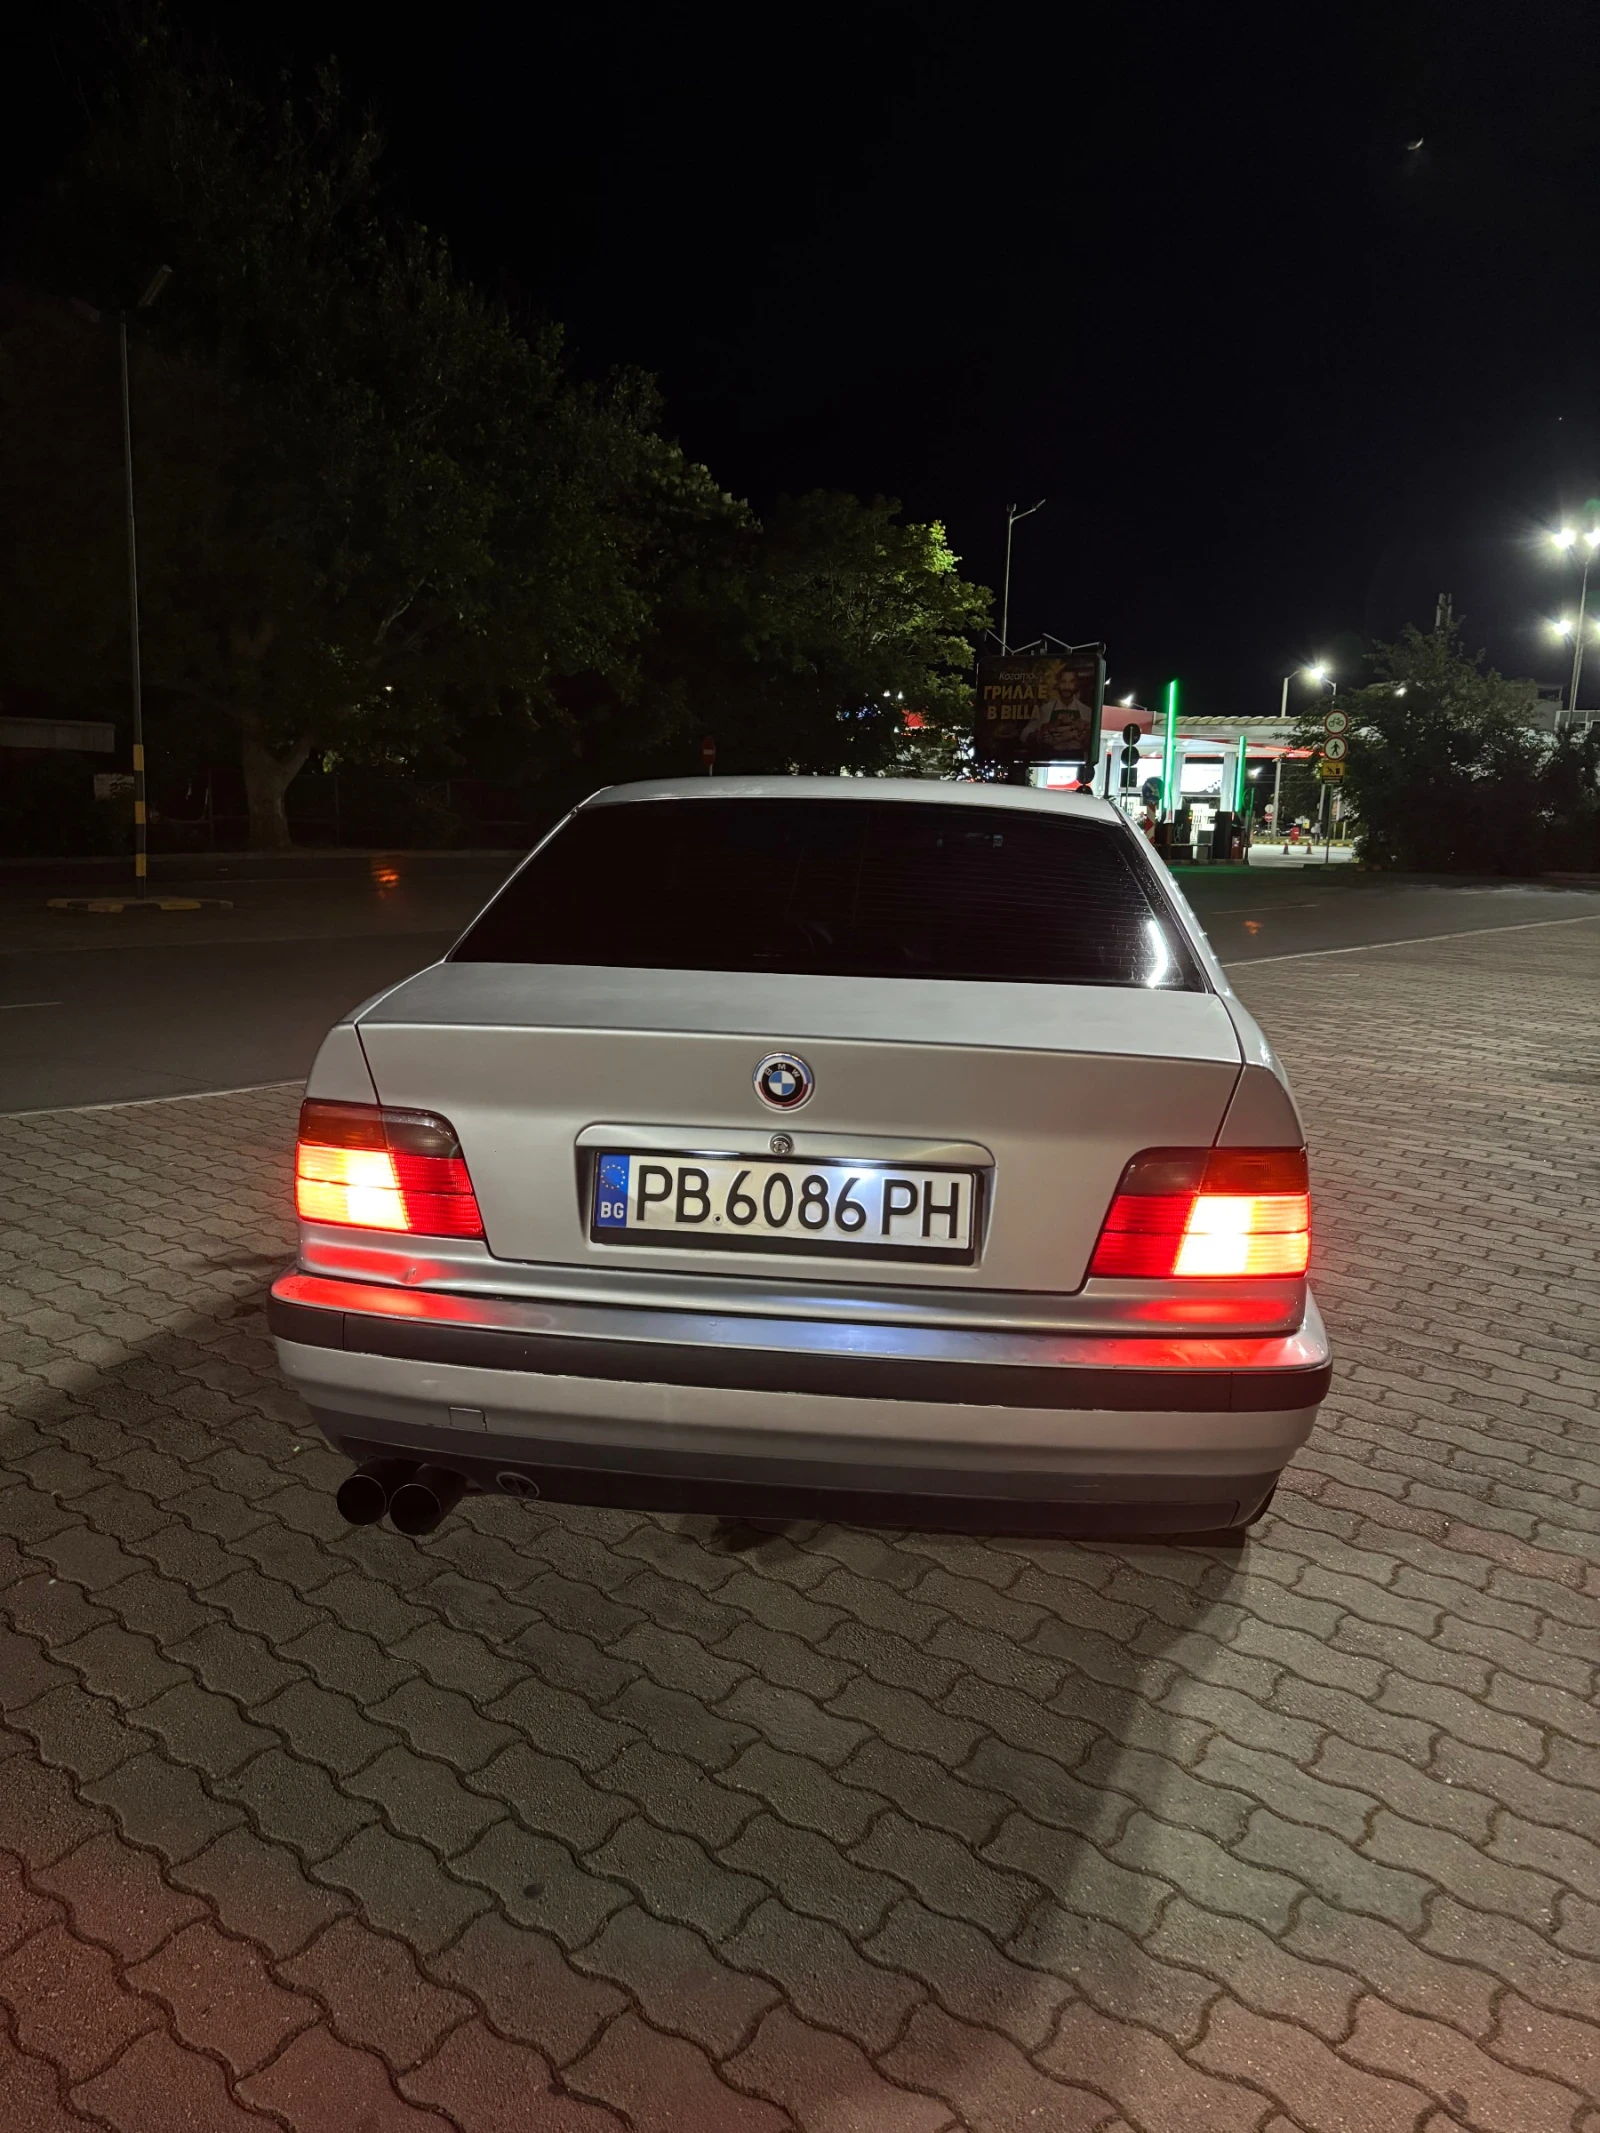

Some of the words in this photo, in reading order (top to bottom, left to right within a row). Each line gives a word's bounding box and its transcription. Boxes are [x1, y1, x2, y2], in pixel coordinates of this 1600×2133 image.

[983, 685, 1034, 700] ГРИЛА
[1038, 684, 1048, 700] Е
[987, 705, 997, 720] В
[1000, 704, 1041, 720] BILLA
[763, 1063, 801, 1078] BMW
[636, 1164, 711, 1224] PB
[725, 1169, 867, 1233] 6086
[881, 1178, 960, 1239] PH
[600, 1201, 625, 1220] BG
